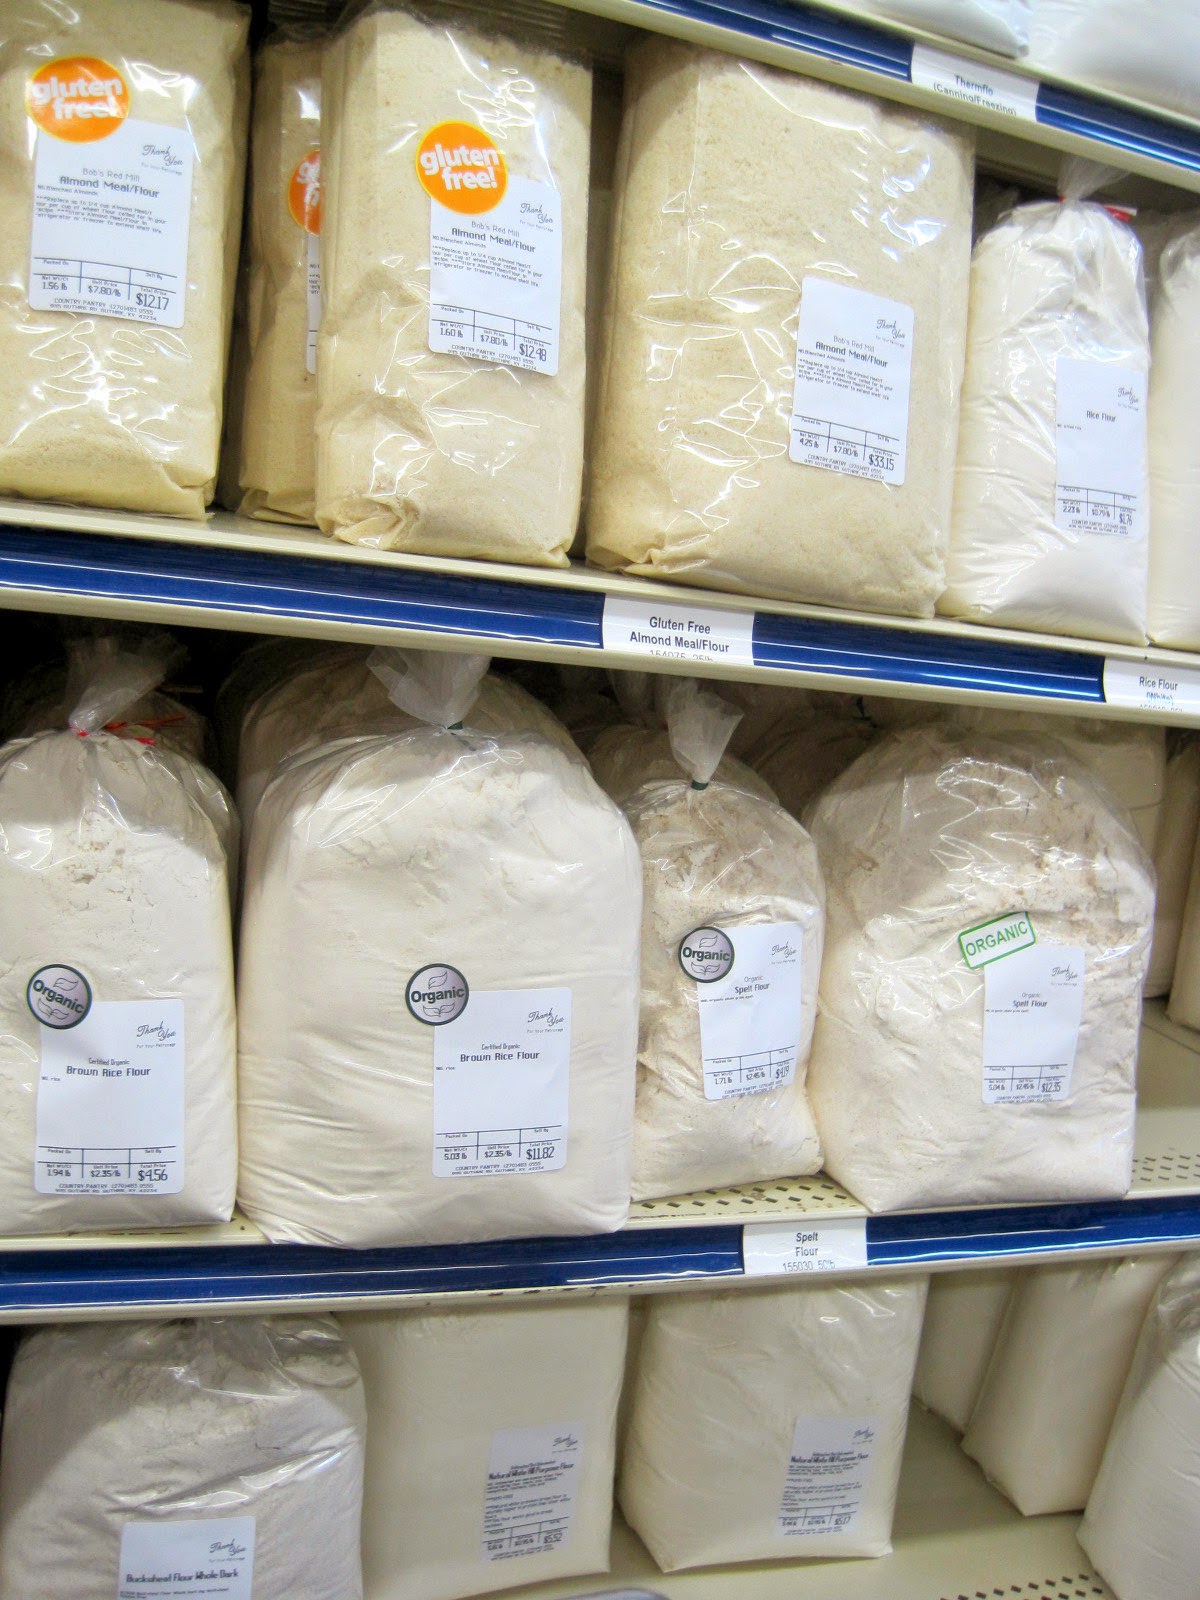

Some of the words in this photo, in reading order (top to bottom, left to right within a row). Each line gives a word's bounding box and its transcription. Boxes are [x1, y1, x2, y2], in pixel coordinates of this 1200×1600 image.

[31, 77, 123, 105] gluten
[955, 75, 993, 96] Thermflo
[142, 144, 171, 157] Thank
[163, 154, 183, 167] You
[419, 143, 499, 175] gluten
[83, 167, 104, 177] Bob's
[107, 169, 123, 180] Red
[126, 172, 140, 182] Mill
[442, 165, 496, 190] free!
[59, 175, 99, 188] Almond
[104, 181, 160, 198] Meal/Flour
[520, 202, 543, 214] Thank
[537, 213, 553, 224] You
[471, 220, 490, 231] Bob's
[492, 223, 505, 234] Red
[508, 227, 520, 238] Mill
[451, 227, 486, 241] Almond
[490, 235, 536, 252] Meal/Flour
[42, 281, 59, 290] 1.56
[135, 292, 169, 310] $12.17
[440, 327, 456, 337] 1.60
[876, 319, 896, 329] Thank
[891, 329, 906, 339] You
[833, 335, 850, 346] Bob's
[851, 340, 864, 349] Red
[519, 343, 547, 362] $12.48
[815, 341, 846, 355] Almond
[849, 350, 888, 368] Meal/Flour
[1086, 411, 1099, 419] Rice
[1102, 412, 1116, 422] Flour
[799, 437, 813, 447] 4.25
[868, 454, 895, 471] $33.15
[649, 616, 684, 631] Gluten
[688, 621, 711, 634] Free
[629, 631, 671, 646] Almond
[674, 636, 730, 652] Meal/Flour
[1139, 677, 1156, 688] Rice
[1158, 678, 1178, 691] Flour
[965, 921, 1028, 956] ORGANIC
[682, 946, 731, 962] Organic
[771, 941, 788, 956] Thank
[784, 948, 797, 958] You
[744, 975, 763, 983] Organic
[1051, 964, 1070, 977] Thank
[32, 979, 85, 1014] Organic
[411, 986, 465, 1004] Organic
[735, 985, 752, 994] Spelt
[755, 983, 770, 991] Flour
[1013, 1000, 1028, 1008] Spelt
[527, 1007, 553, 1023] Thank
[546, 1016, 564, 1027] You
[136, 1021, 163, 1038] Thank
[158, 1029, 176, 1041] You
[502, 1043, 520, 1051] Organic
[88, 1057, 110, 1066] Certified
[110, 1058, 130, 1066] Organic
[460, 1054, 491, 1062] Brown
[495, 1052, 514, 1061] Rice
[517, 1051, 540, 1060] Flour
[66, 1066, 98, 1076] Brown
[102, 1068, 122, 1077] Rice
[126, 1067, 151, 1077] Flour
[526, 1146, 555, 1161] $11.82
[48, 1169, 63, 1177] 1.94
[138, 1169, 168, 1181] $4.56
[796, 1232, 819, 1244] Spelt
[795, 1247, 819, 1257] Flour
[209, 1538, 235, 1553] Thank
[228, 1546, 247, 1556] You
[174, 1573, 194, 1582] Flour
[195, 1570, 218, 1579] Whole
[220, 1568, 239, 1578] Dark
